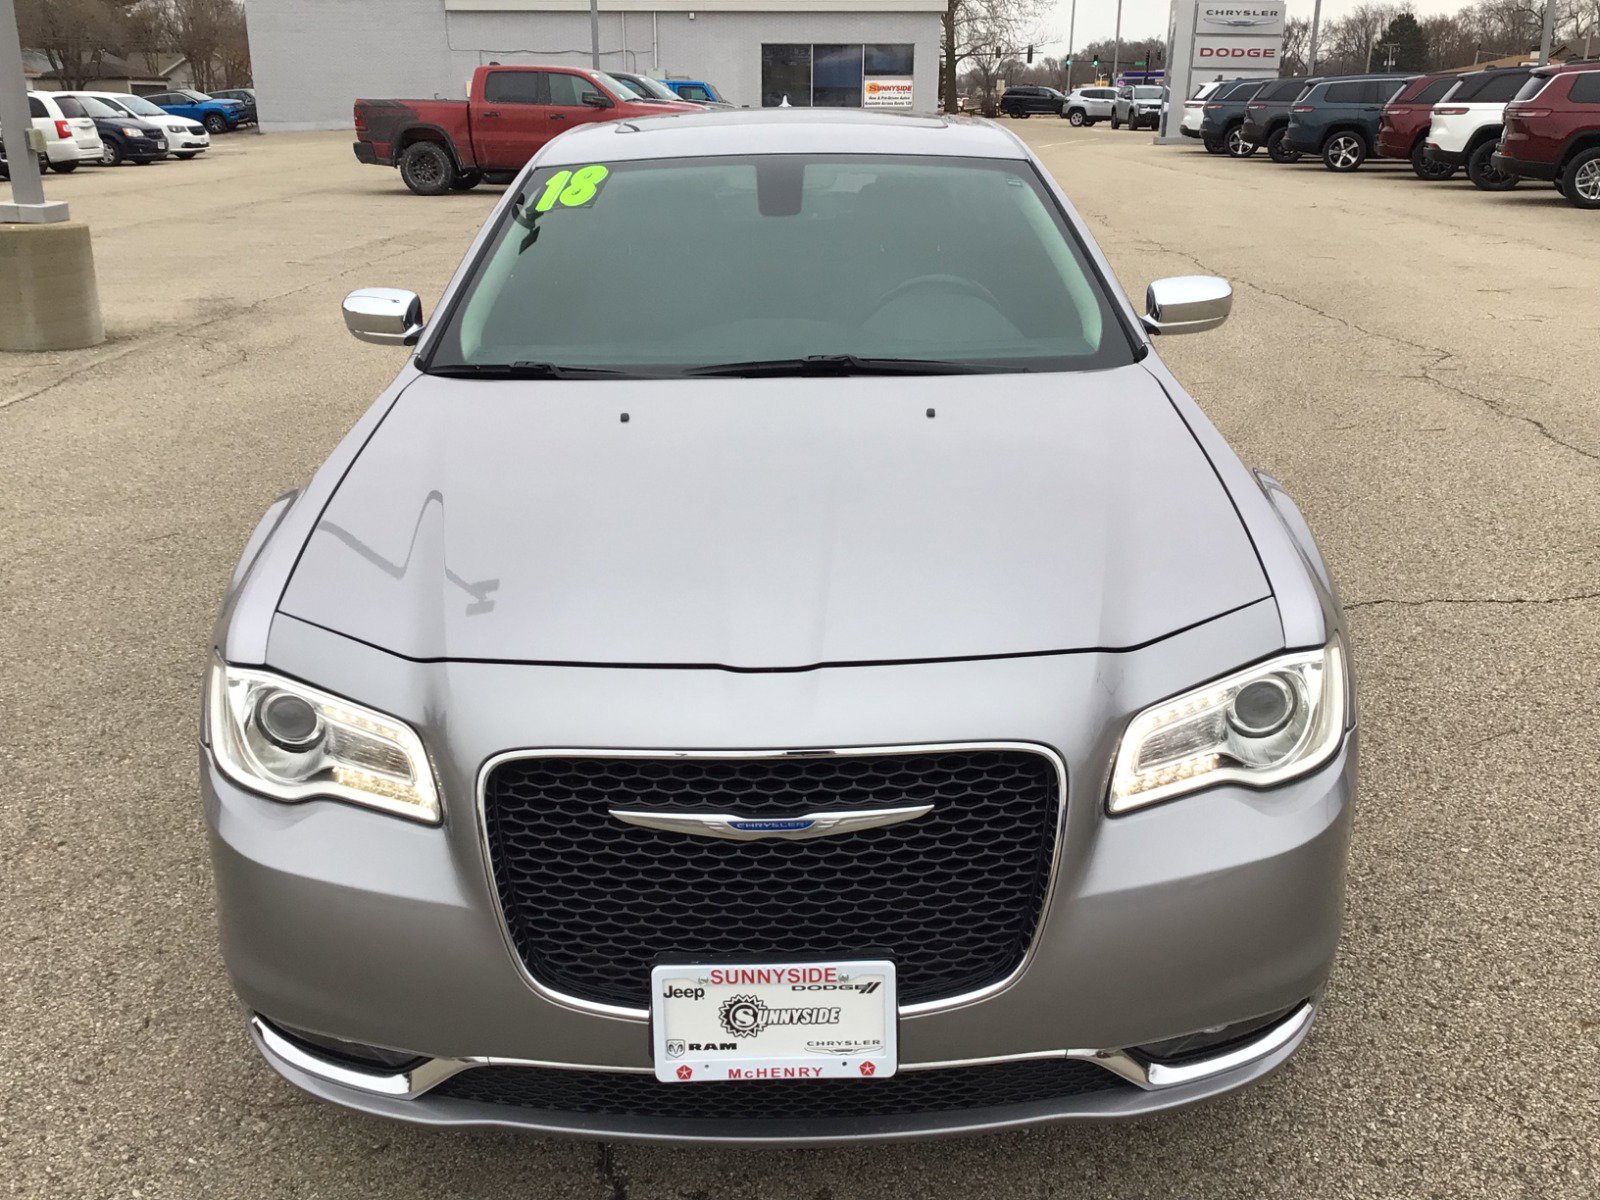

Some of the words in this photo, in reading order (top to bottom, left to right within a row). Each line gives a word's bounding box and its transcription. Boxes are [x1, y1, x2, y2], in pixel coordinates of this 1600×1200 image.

[1206, 9, 1279, 17] CHRYSLER
[1200, 47, 1276, 58] DODGE
[535, 165, 609, 212] 18
[710, 967, 838, 985] SUNNYSIDE
[663, 985, 705, 1000] Jeep
[791, 984, 865, 992] DODGE
[734, 1007, 841, 1026] SUNNYSIDE
[688, 1042, 738, 1051] RAM
[728, 1067, 823, 1079] McHENRY
